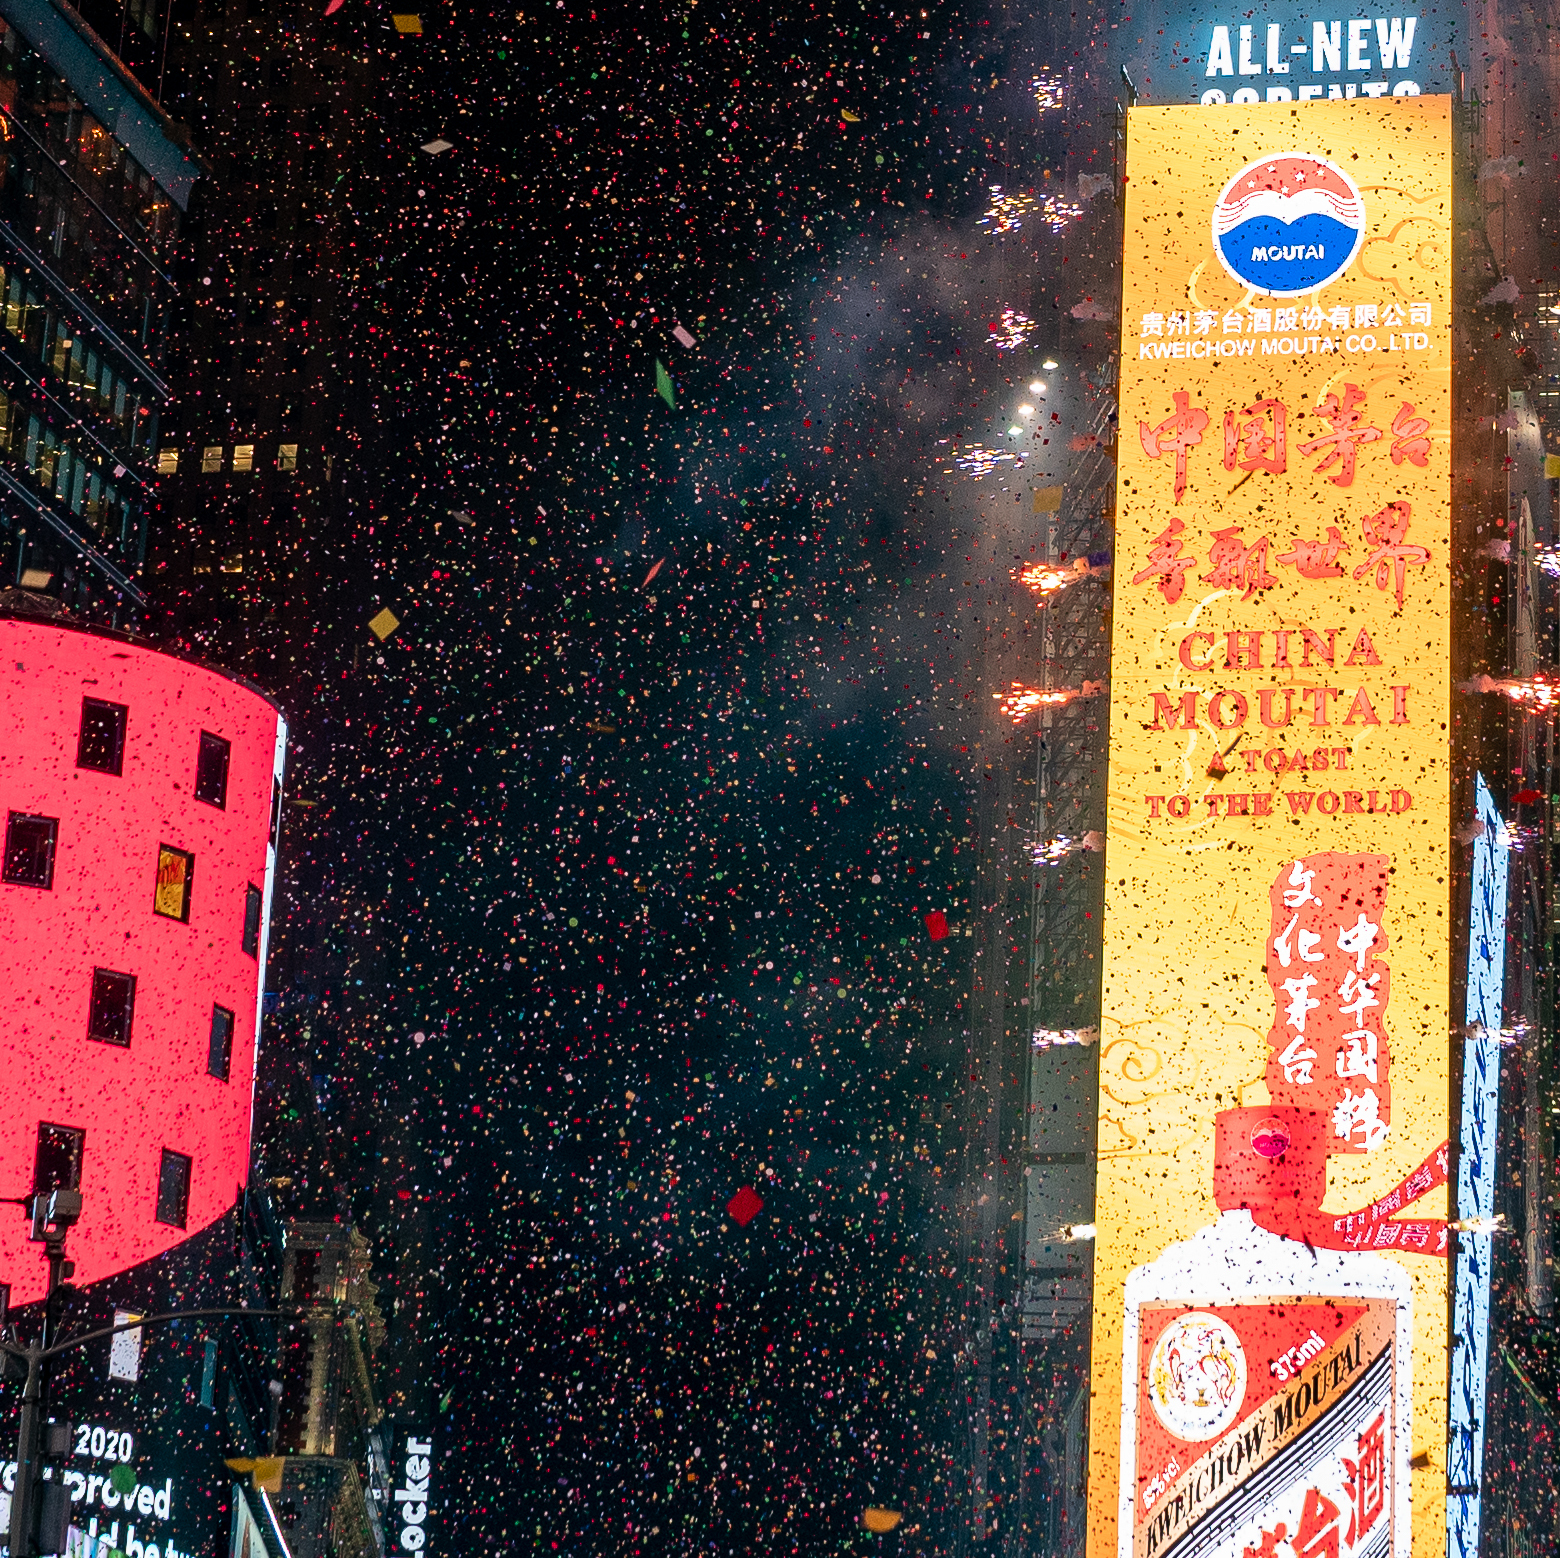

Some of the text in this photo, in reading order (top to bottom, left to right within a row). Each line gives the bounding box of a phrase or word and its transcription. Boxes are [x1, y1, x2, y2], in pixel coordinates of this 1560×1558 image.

[1205, 16, 1418, 77] ALL-NEW
[1250, 244, 1325, 262] MOUTAI
[1139, 302, 1432, 338] 贵州茅台酒股份有限公司
[1138, 338, 1256, 360] KWEICHOW
[1261, 336, 1340, 355] MOUTAI
[1139, 382, 1433, 503] 中国茅台
[1131, 500, 1433, 610] 香飘世界
[1178, 627, 1383, 672] CHINA
[1149, 684, 1411, 731] MOUTAI
[1240, 746, 1350, 774] TOAST
[1144, 788, 1413, 819] TO THE WORLD
[1273, 859, 1325, 1085] 文化茅台
[1269, 1328, 1327, 1382] 375ml
[74, 1423, 134, 1464] 2020
[1147, 1331, 1363, 1558] KWEICHOW MOUTAI
[395, 1436, 432, 1558] ocker
